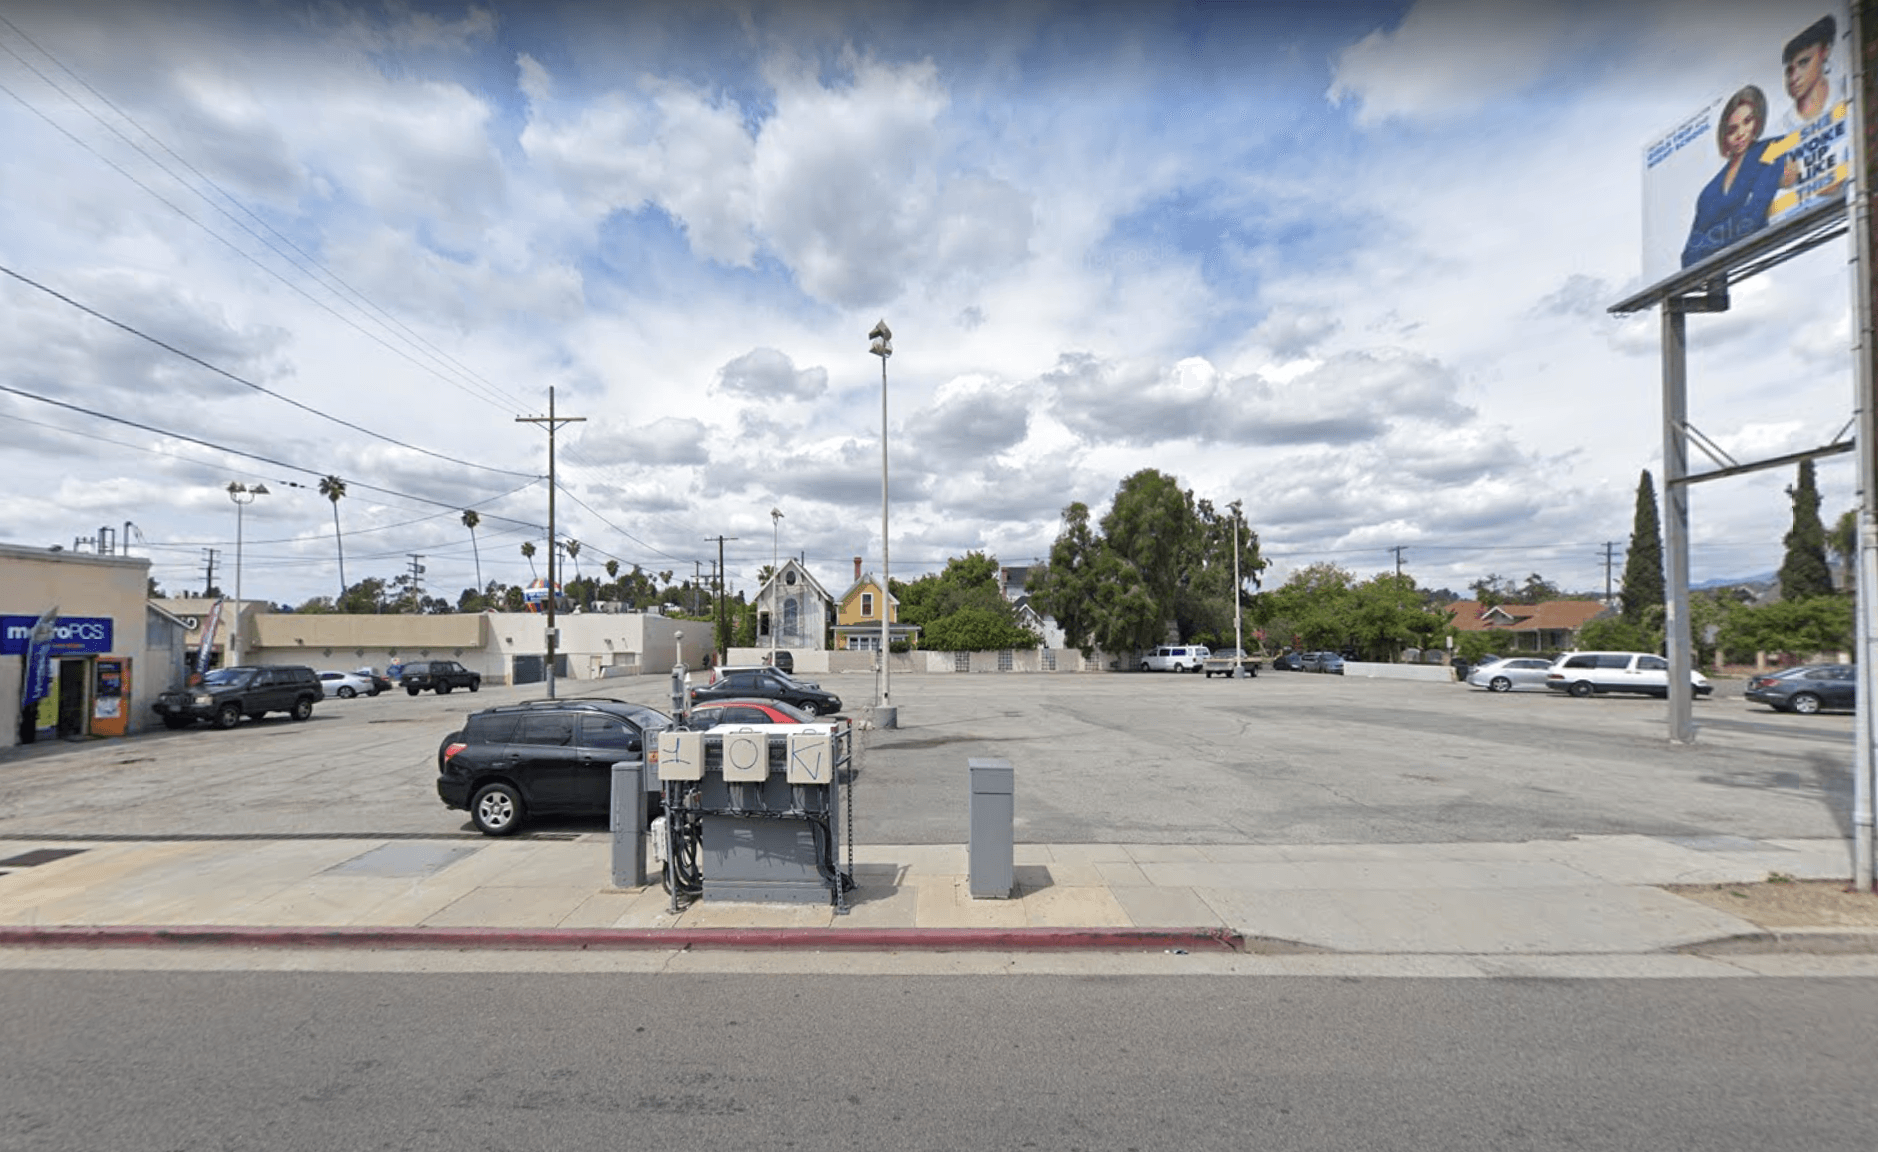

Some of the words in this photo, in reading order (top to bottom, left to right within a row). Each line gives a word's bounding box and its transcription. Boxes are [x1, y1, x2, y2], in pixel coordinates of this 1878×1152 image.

[1784, 120, 1846, 161] WOKE
[1798, 153, 1837, 184] LIKE
[1804, 145, 1829, 167] UP
[7, 623, 105, 640] mroPCS
